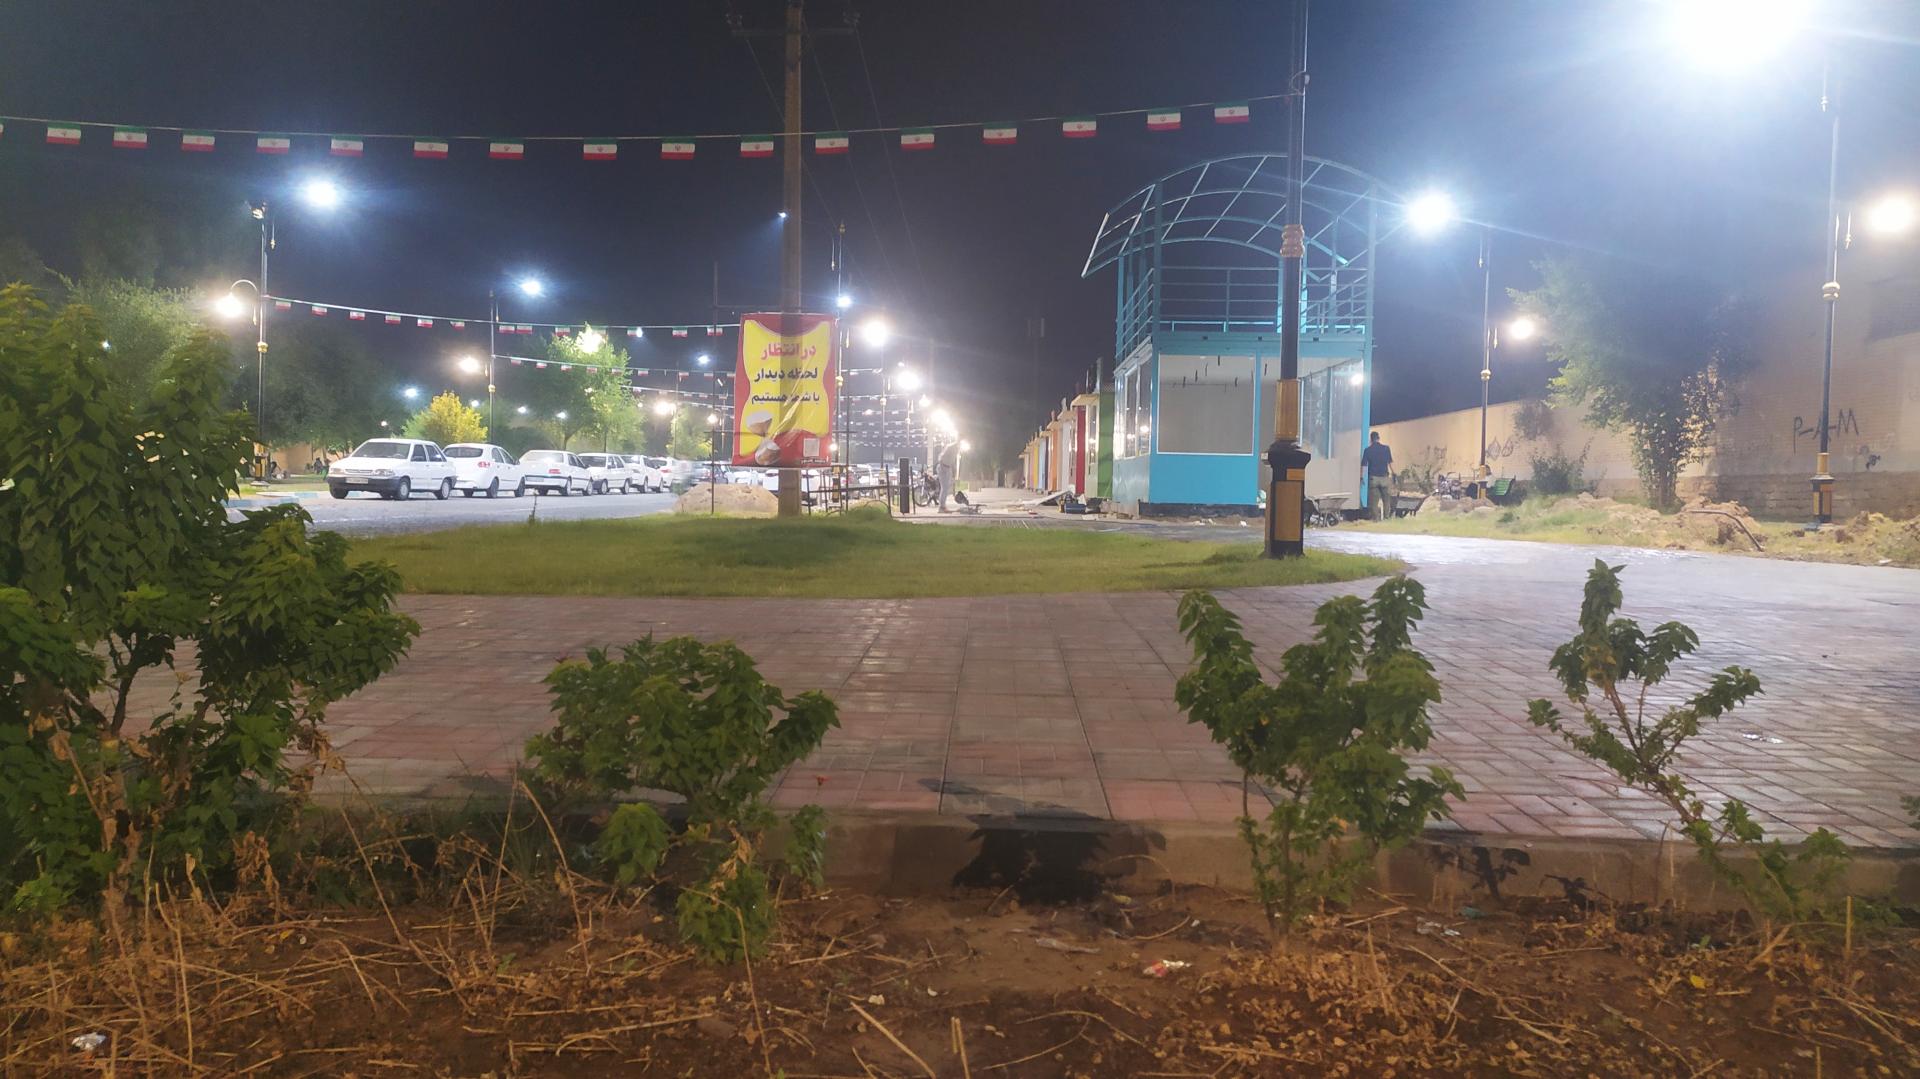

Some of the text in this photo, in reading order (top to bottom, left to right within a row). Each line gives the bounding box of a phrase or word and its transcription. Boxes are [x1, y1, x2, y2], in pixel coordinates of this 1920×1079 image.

[761, 343, 817, 360] در انتظار
[754, 367, 818, 382] لحظه دیدار
[751, 391, 788, 405] هستیم
